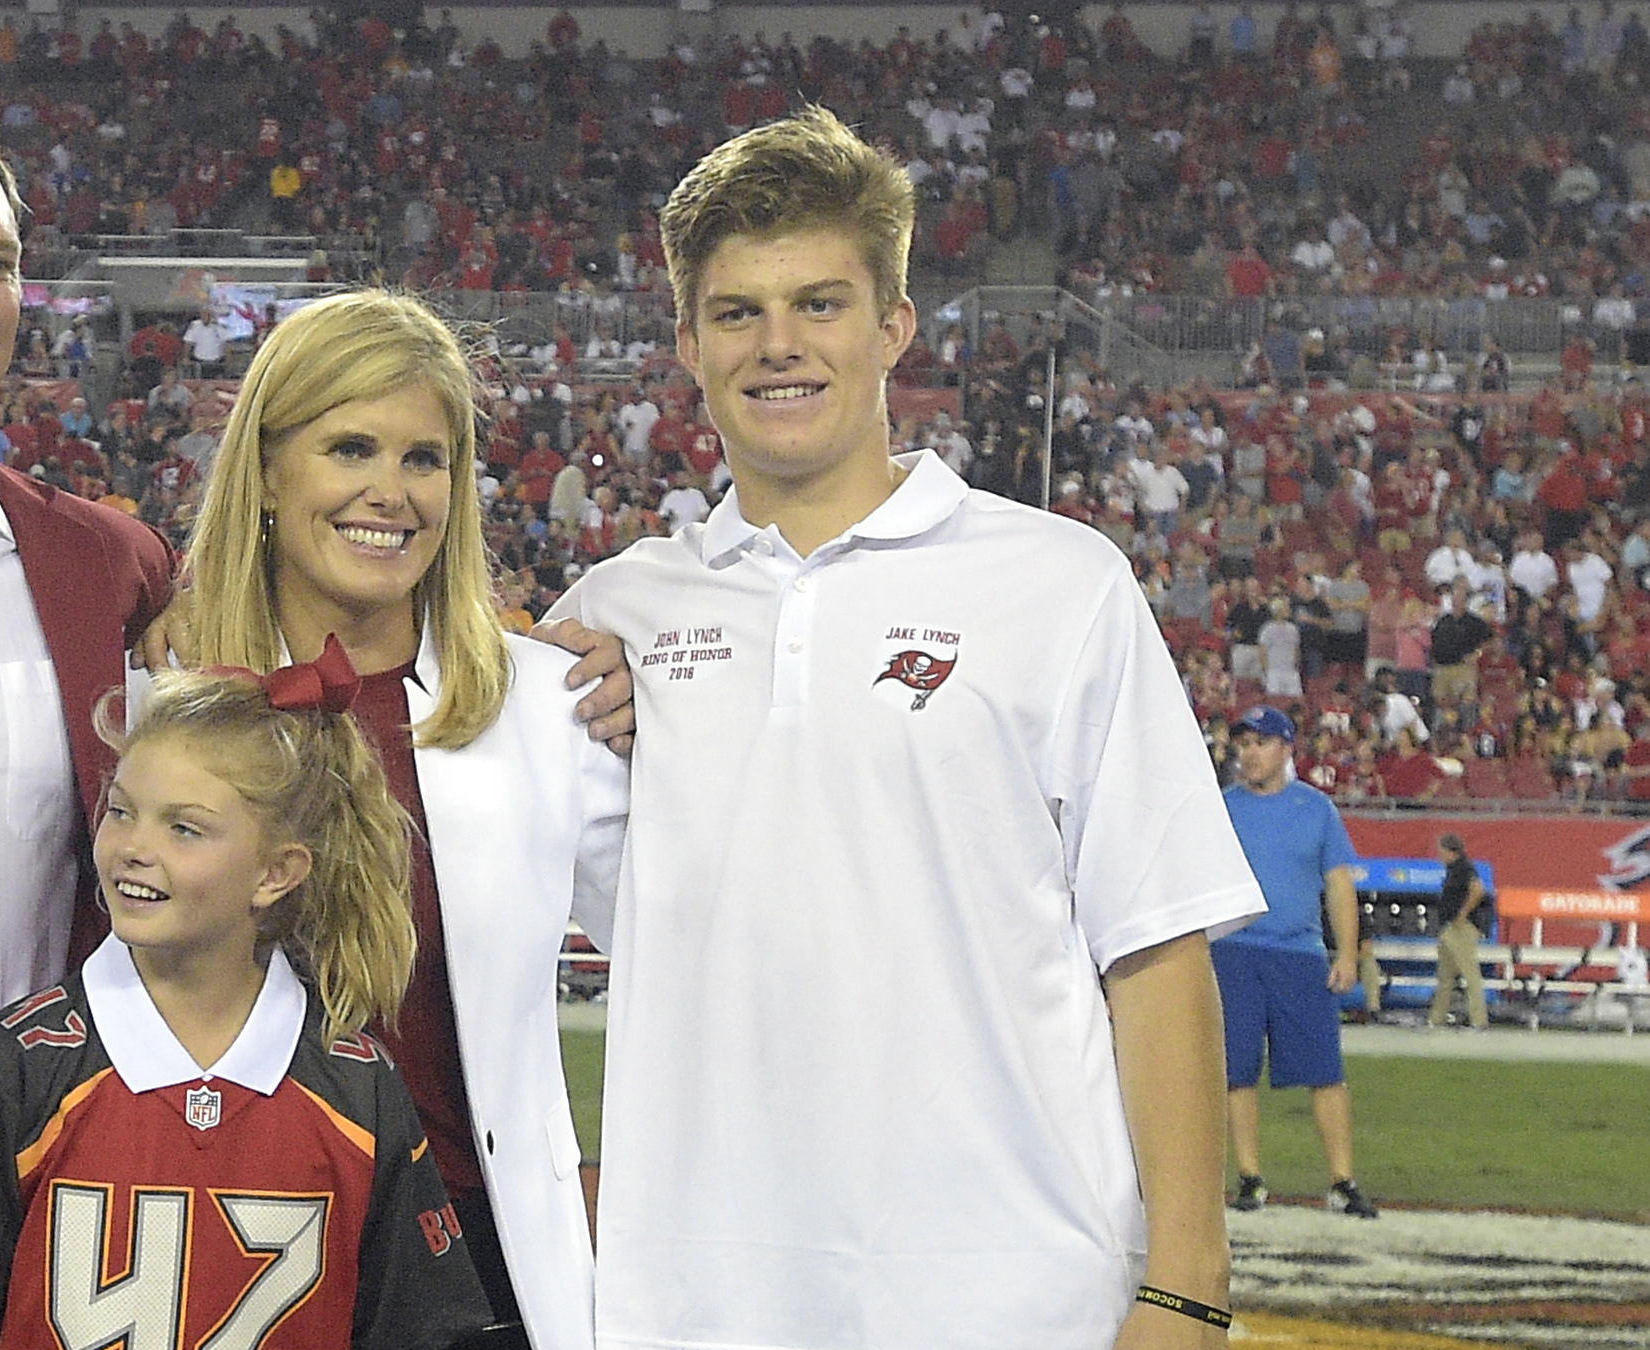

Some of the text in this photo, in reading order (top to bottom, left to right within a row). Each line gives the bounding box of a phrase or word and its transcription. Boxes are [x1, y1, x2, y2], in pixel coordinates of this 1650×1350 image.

[654, 627, 723, 649] JOHN LYNCH
[885, 627, 961, 646] JAKE LYNCH
[641, 647, 733, 668] RING OF HONOR
[192, 1105, 216, 1123] NFL
